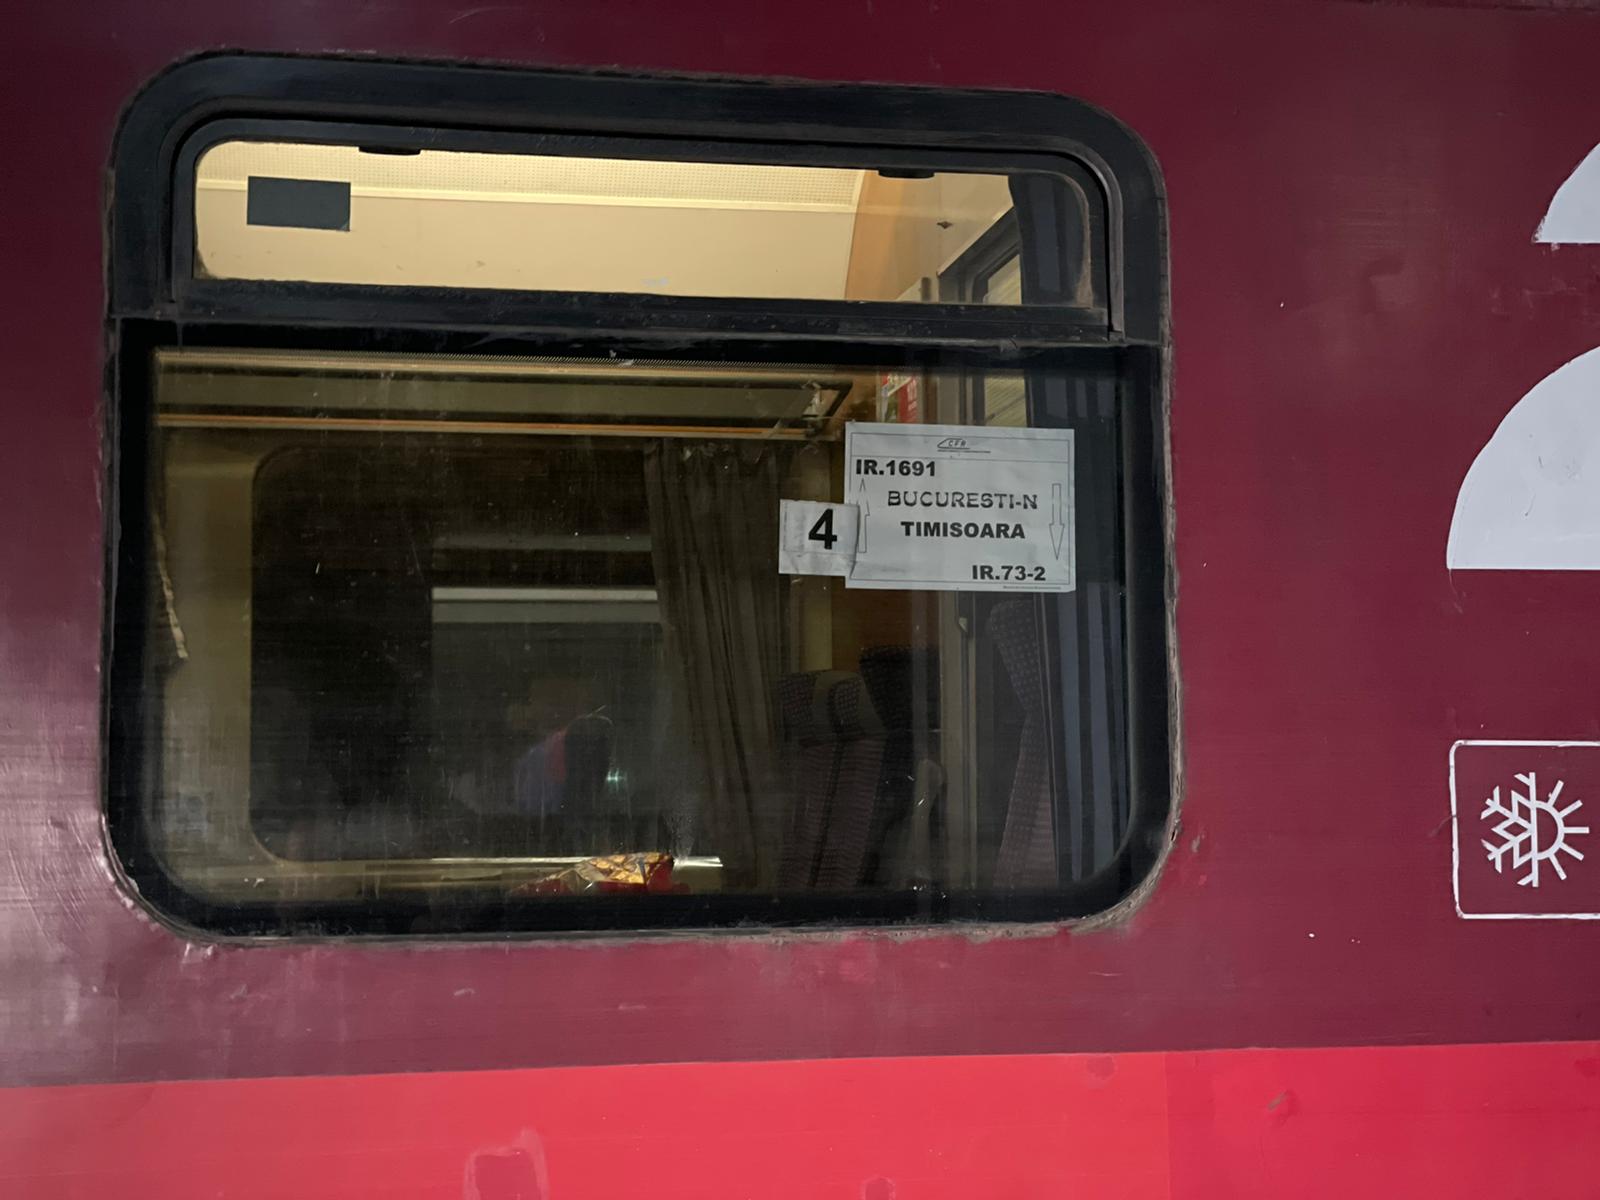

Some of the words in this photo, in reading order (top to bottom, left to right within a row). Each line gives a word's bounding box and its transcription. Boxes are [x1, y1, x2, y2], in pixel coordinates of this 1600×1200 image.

[856, 459, 936, 477] IR.1691
[888, 491, 1038, 510] BUCURESTI-N
[808, 508, 837, 550] 4
[901, 521, 1025, 539] TIMISOARA
[972, 565, 1046, 581] IR.73-2
